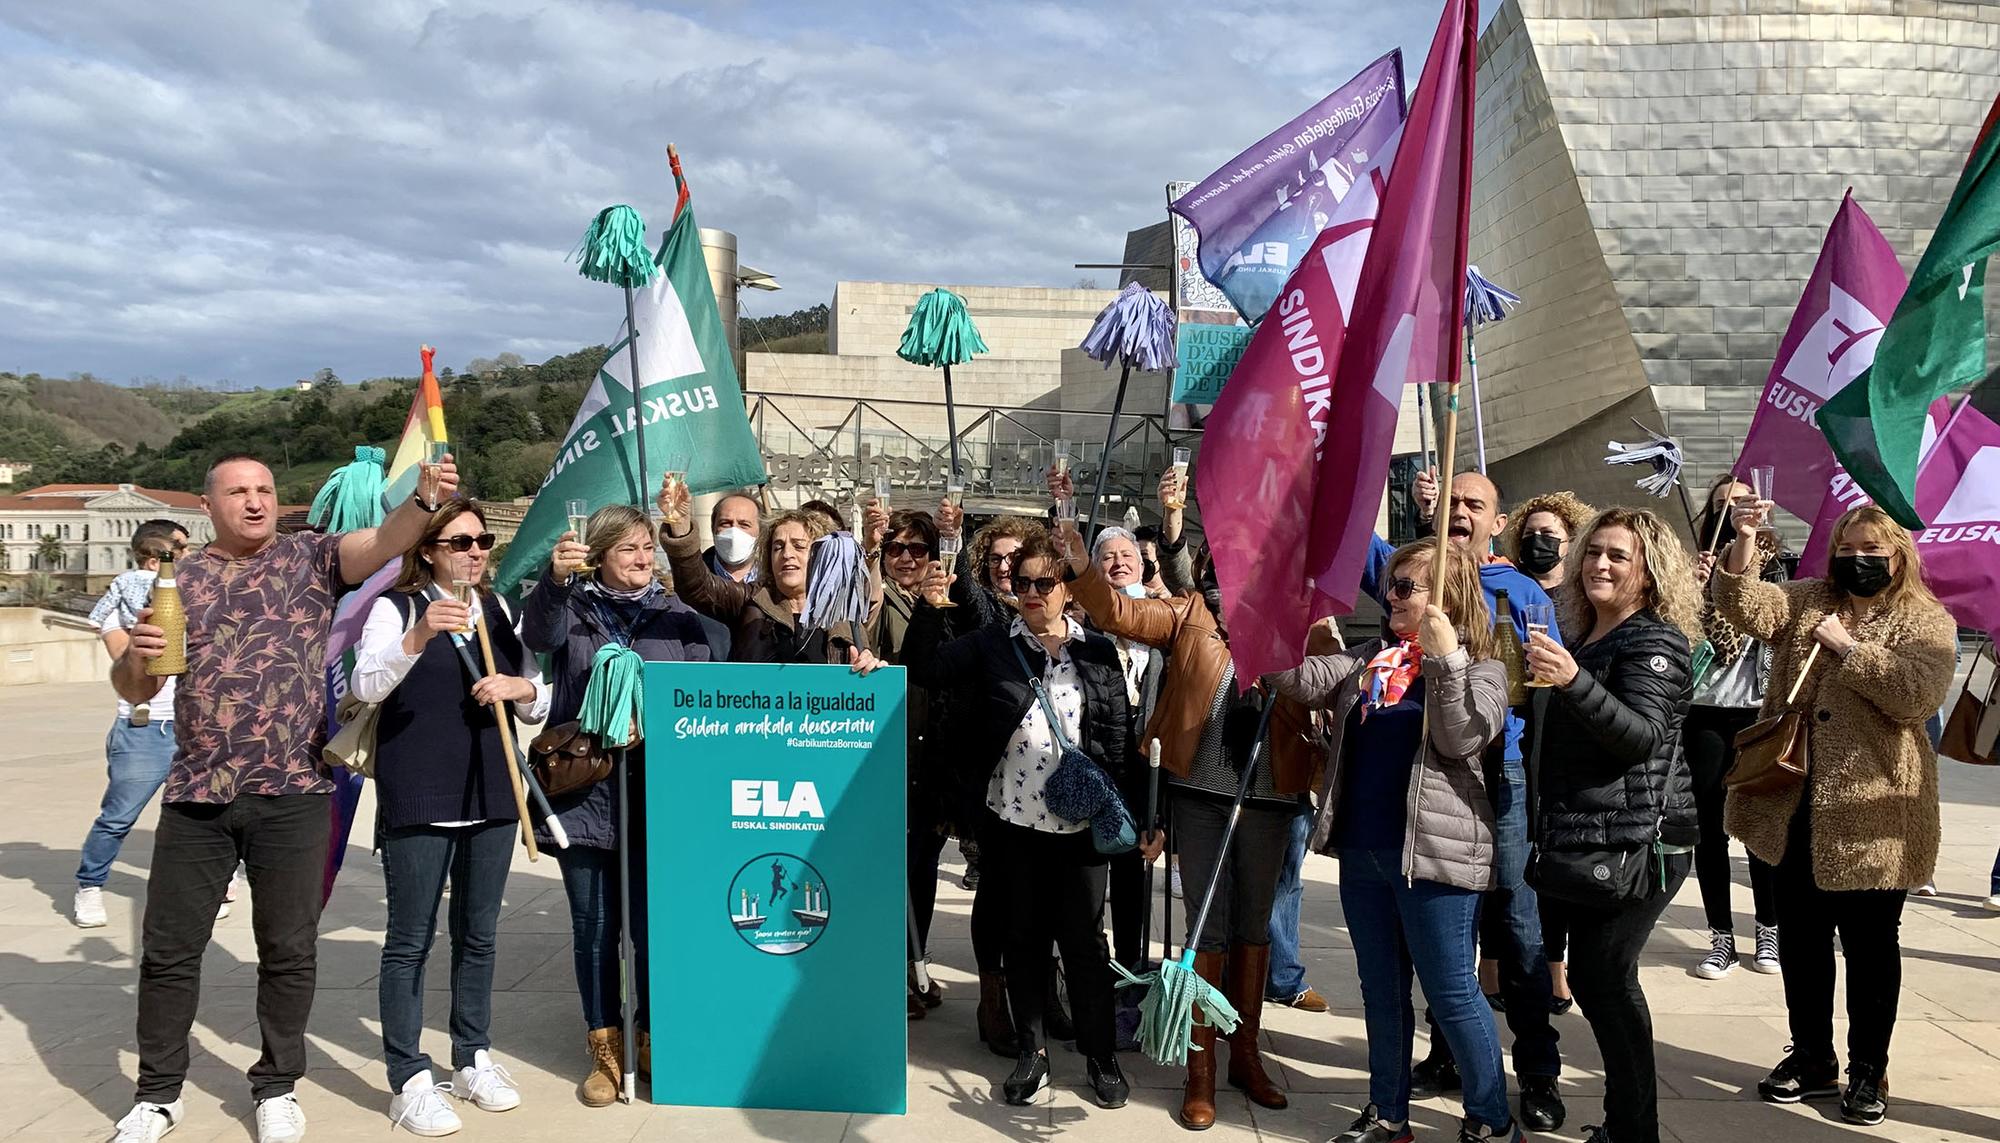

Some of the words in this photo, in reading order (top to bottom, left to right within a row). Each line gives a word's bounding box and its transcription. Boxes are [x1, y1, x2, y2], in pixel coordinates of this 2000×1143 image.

[1184, 376, 1209, 392] DE
[1279, 288, 1332, 462] SINDIKA
[762, 442, 973, 491] genheim
[674, 688, 695, 708] De
[699, 689, 713, 709] la
[716, 690, 771, 710] brecha
[774, 695, 784, 710] a
[789, 691, 803, 711] la
[806, 692, 875, 716] igualdad
[674, 715, 729, 740] Soldata
[734, 714, 793, 739] arrakala
[799, 714, 875, 736] deuseztatu
[786, 738, 873, 749] #GarbikuntzaBorrokan
[731, 780, 825, 818] ELA
[731, 821, 768, 830] EUSKAL
[769, 822, 825, 832] SINDIKATUA
